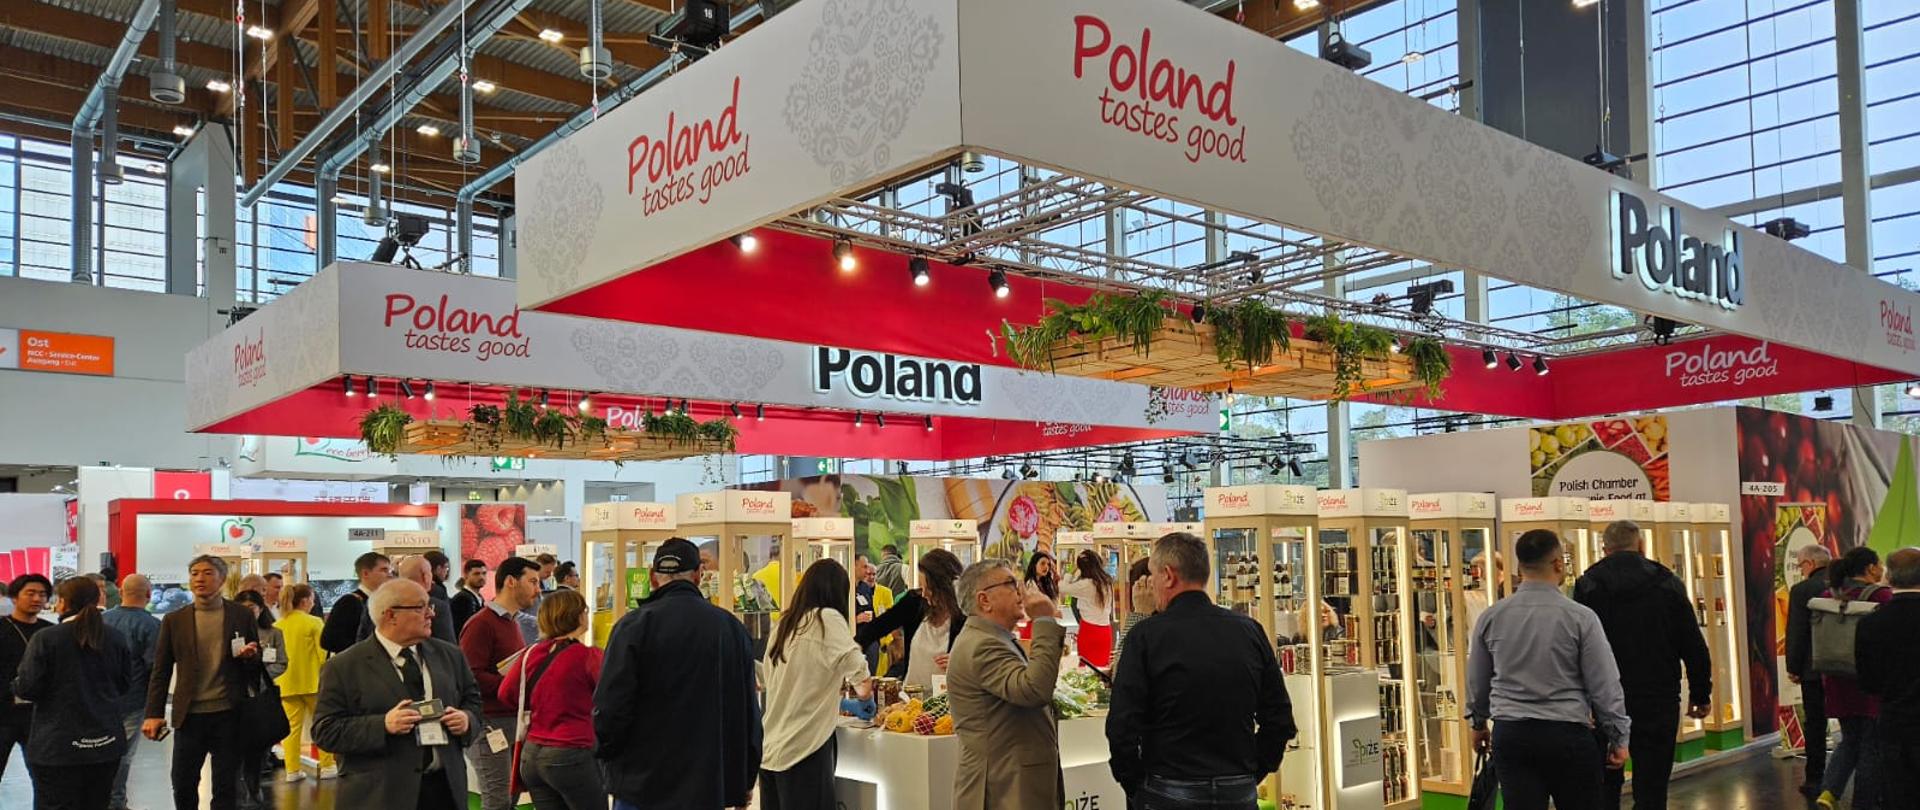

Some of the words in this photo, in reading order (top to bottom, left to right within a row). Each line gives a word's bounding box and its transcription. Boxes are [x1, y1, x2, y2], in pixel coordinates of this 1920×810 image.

[1073, 14, 1237, 126] Poland
[627, 75, 742, 195] Poland
[1098, 87, 1179, 144] tastes
[1184, 126, 1248, 164] good
[642, 170, 695, 218] tastes
[699, 134, 751, 205] good
[1614, 190, 1744, 308] Poland
[384, 292, 523, 339] Poland
[1880, 298, 1913, 336] Poland
[26, 336, 49, 348] Ost
[234, 326, 264, 374] Poland
[404, 328, 471, 354] tastes
[476, 336, 531, 362] good
[1665, 339, 1772, 378] Poland
[1680, 369, 1730, 388] tastes
[1733, 358, 1779, 386] good
[742, 497, 773, 510] Poland
[1217, 491, 1248, 505] Poland
[1559, 479, 1589, 492] Polish
[1591, 477, 1639, 490] Chamber
[634, 507, 664, 519] Poland
[352, 529, 379, 537] 4A-211
